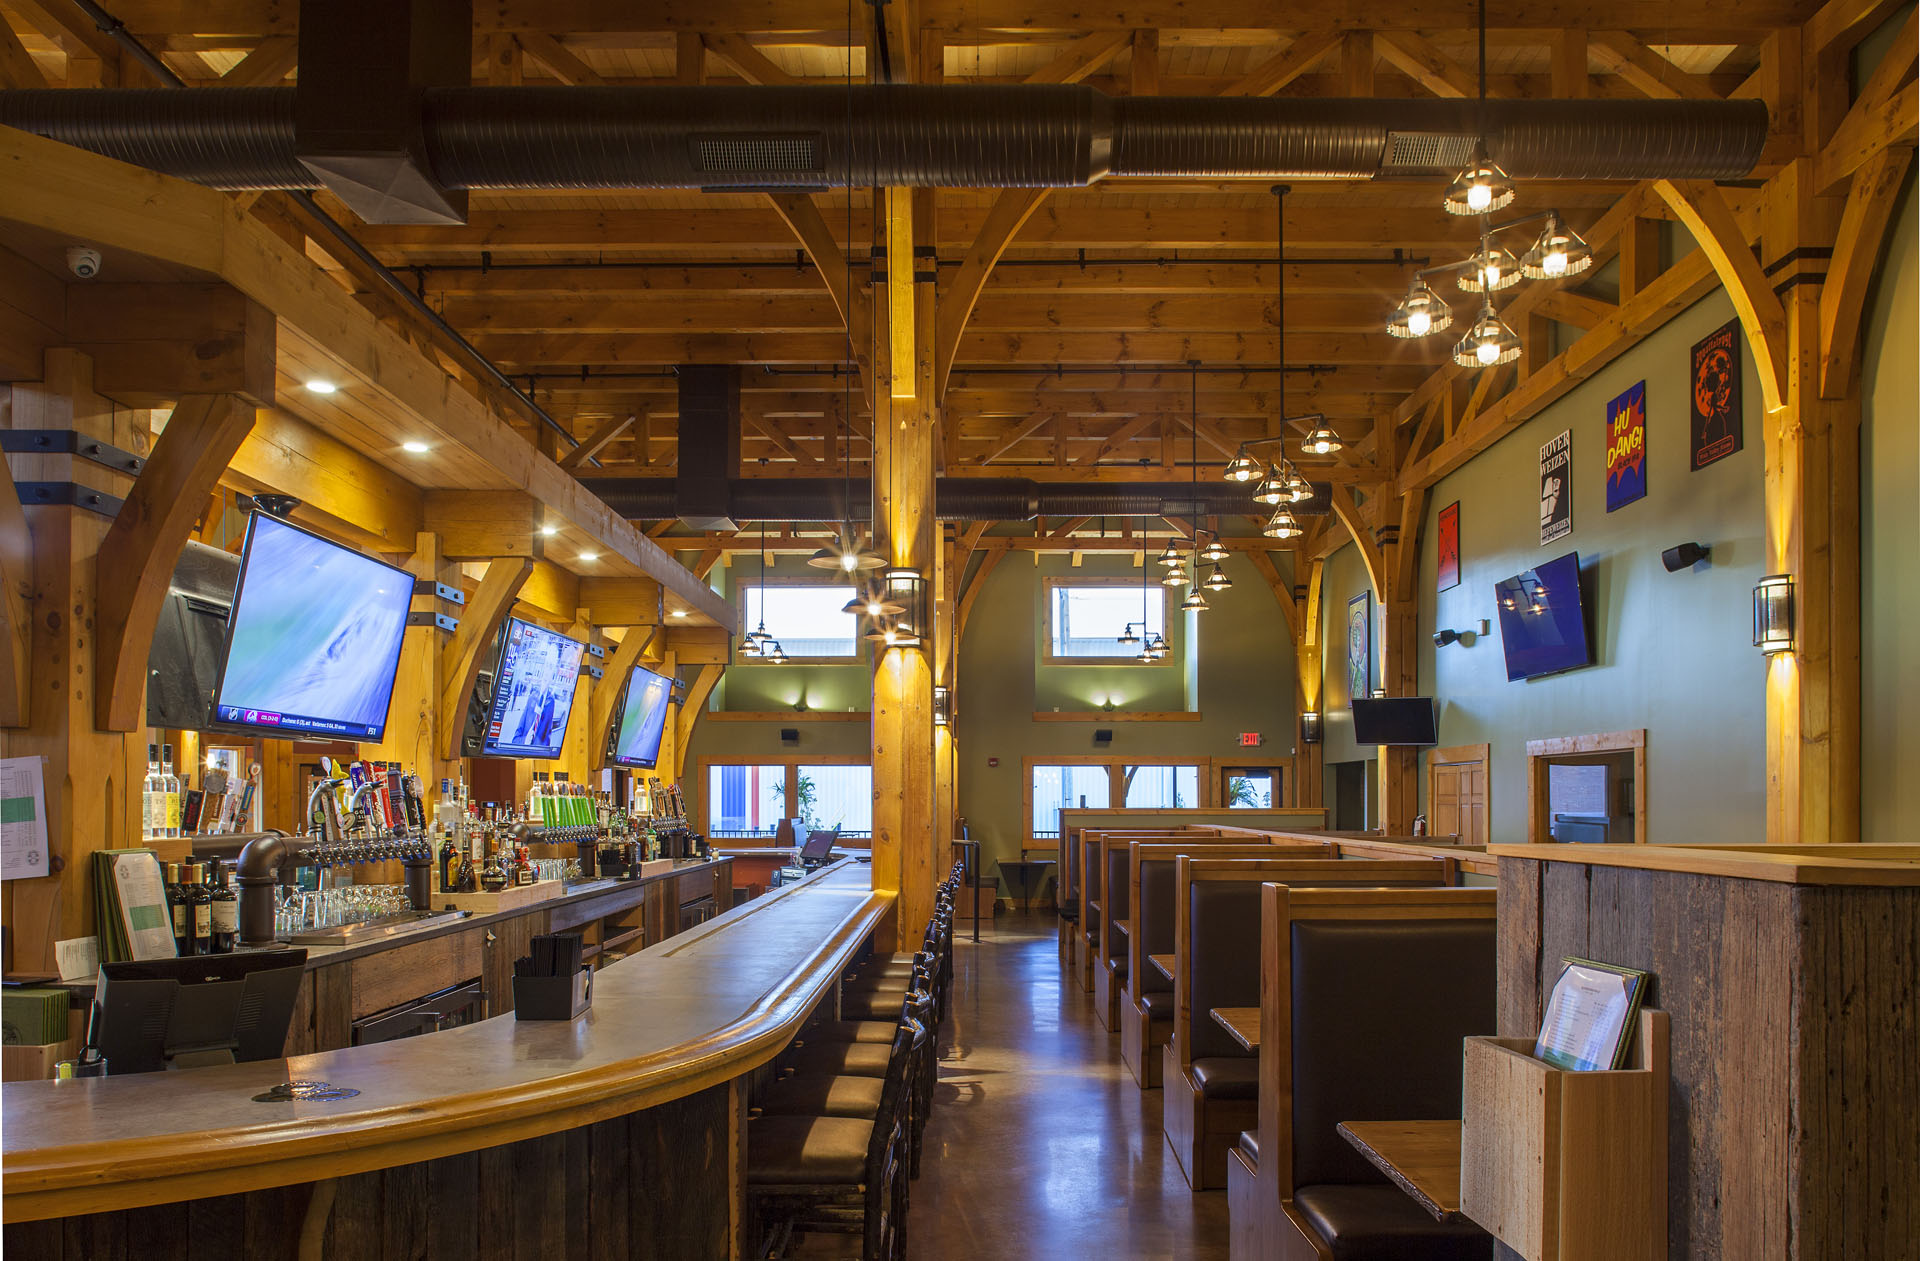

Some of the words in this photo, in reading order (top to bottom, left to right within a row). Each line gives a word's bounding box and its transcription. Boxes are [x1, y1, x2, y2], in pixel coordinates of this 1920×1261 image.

[1614, 407, 1630, 437] HU
[1541, 431, 1568, 461] HOVER
[1607, 426, 1643, 469] DANG!
[1541, 450, 1568, 475] WEIZEN
[1243, 732, 1258, 745] EXIT
